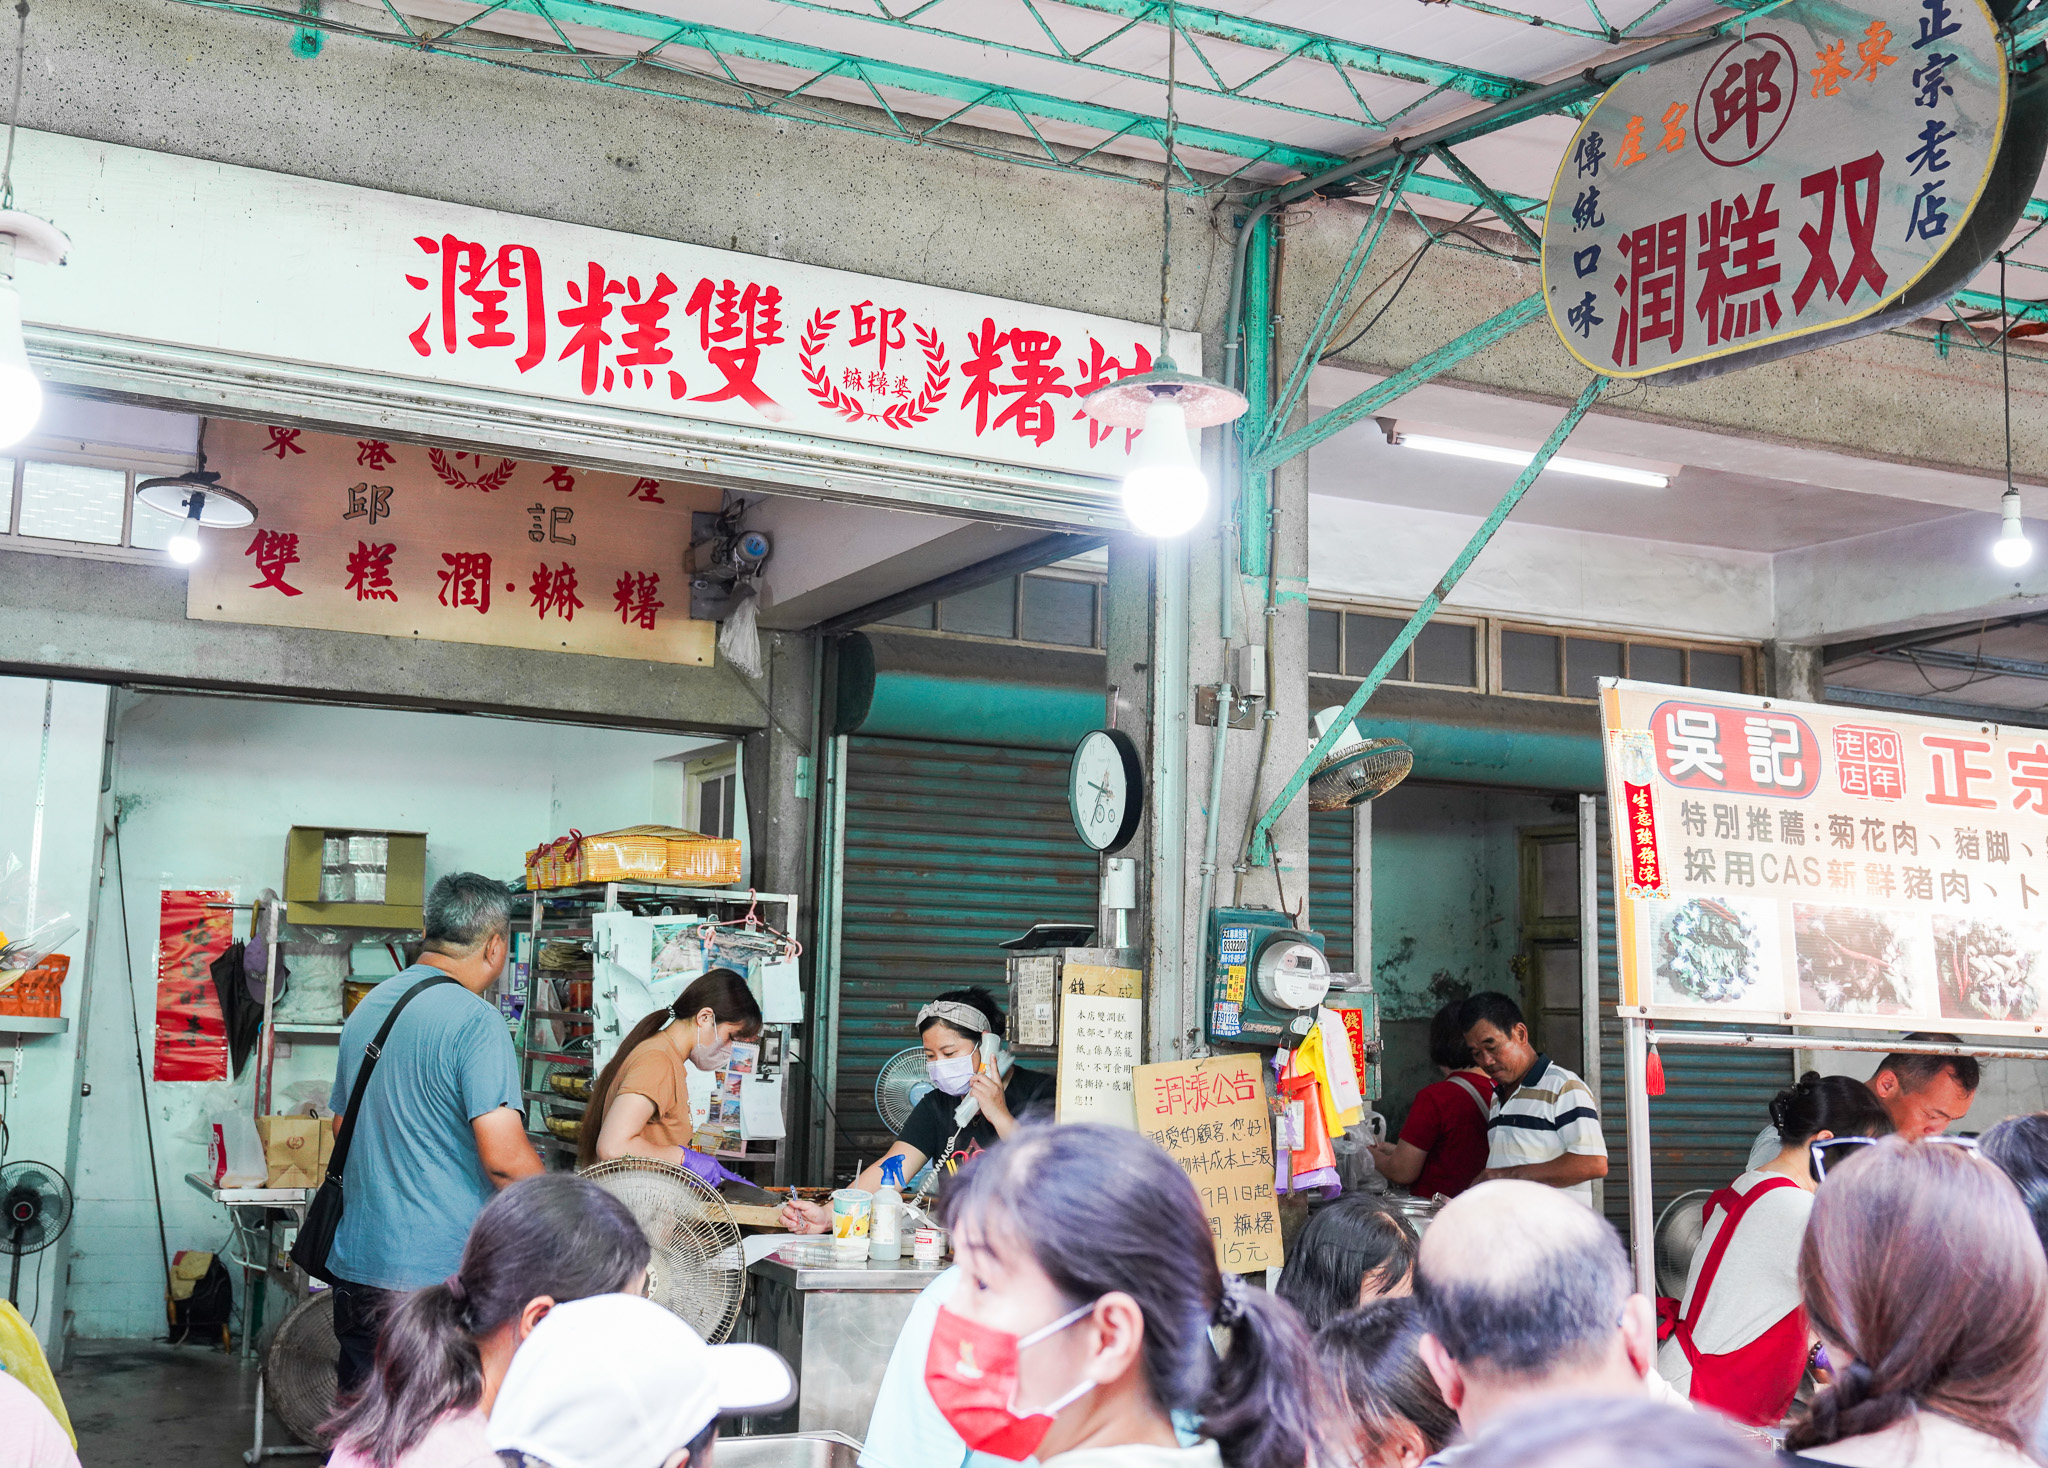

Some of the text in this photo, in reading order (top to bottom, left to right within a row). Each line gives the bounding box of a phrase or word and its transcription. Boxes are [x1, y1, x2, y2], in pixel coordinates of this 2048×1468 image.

[1707, 50, 1781, 149] 邱
[1905, 0, 1962, 243] 正宗老店
[1567, 131, 1605, 340] 傳統口味
[849, 301, 907, 371] 邱
[1665, 708, 1802, 788] 吳記
[1223, 940, 1246, 952] 8332200
[1154, 1070, 1257, 1116] 調漲公告
[1223, 1241, 1269, 1265] 15元
